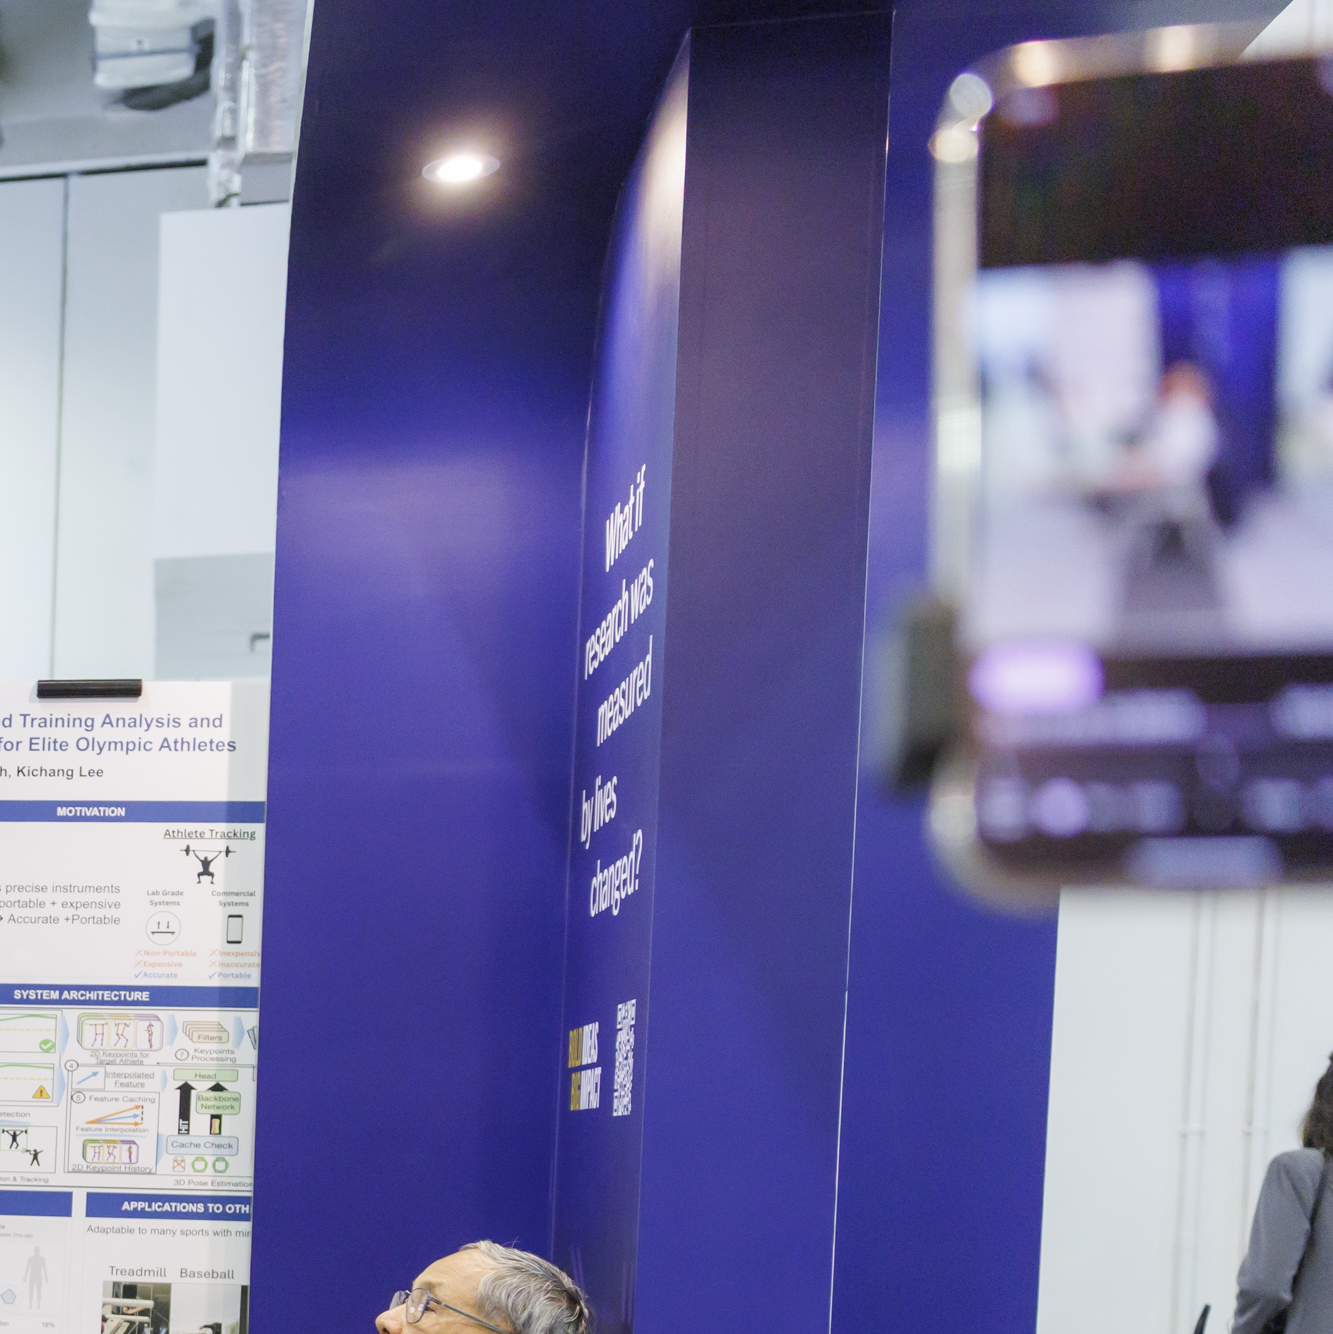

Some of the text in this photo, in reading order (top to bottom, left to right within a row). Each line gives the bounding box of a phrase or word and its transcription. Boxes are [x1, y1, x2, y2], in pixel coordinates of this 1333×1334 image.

[605, 463, 647, 572] What if
[584, 558, 655, 681] research was
[596, 634, 653, 747] measured
[19, 713, 95, 732] Training
[100, 713, 181, 732] Analysis
[188, 713, 223, 728] and
[28, 737, 69, 752] Elite
[75, 737, 153, 755] Olympic
[158, 737, 237, 752] Athletes
[16, 766, 74, 780] Kichang
[79, 766, 104, 777] Lee
[56, 806, 126, 817] MOTIVATION
[580, 774, 618, 850] by lives
[163, 829, 256, 840] Athlete Tracking
[590, 828, 643, 918] changed?
[5, 882, 48, 895] precise
[51, 882, 121, 894] instruments
[13, 989, 150, 1001] SYSTEM ARCHITECTURE
[121, 1201, 204, 1213] APPLICATIONS
[207, 1203, 223, 1213] TO
[109, 1265, 235, 1280] Treadmill Baseball
